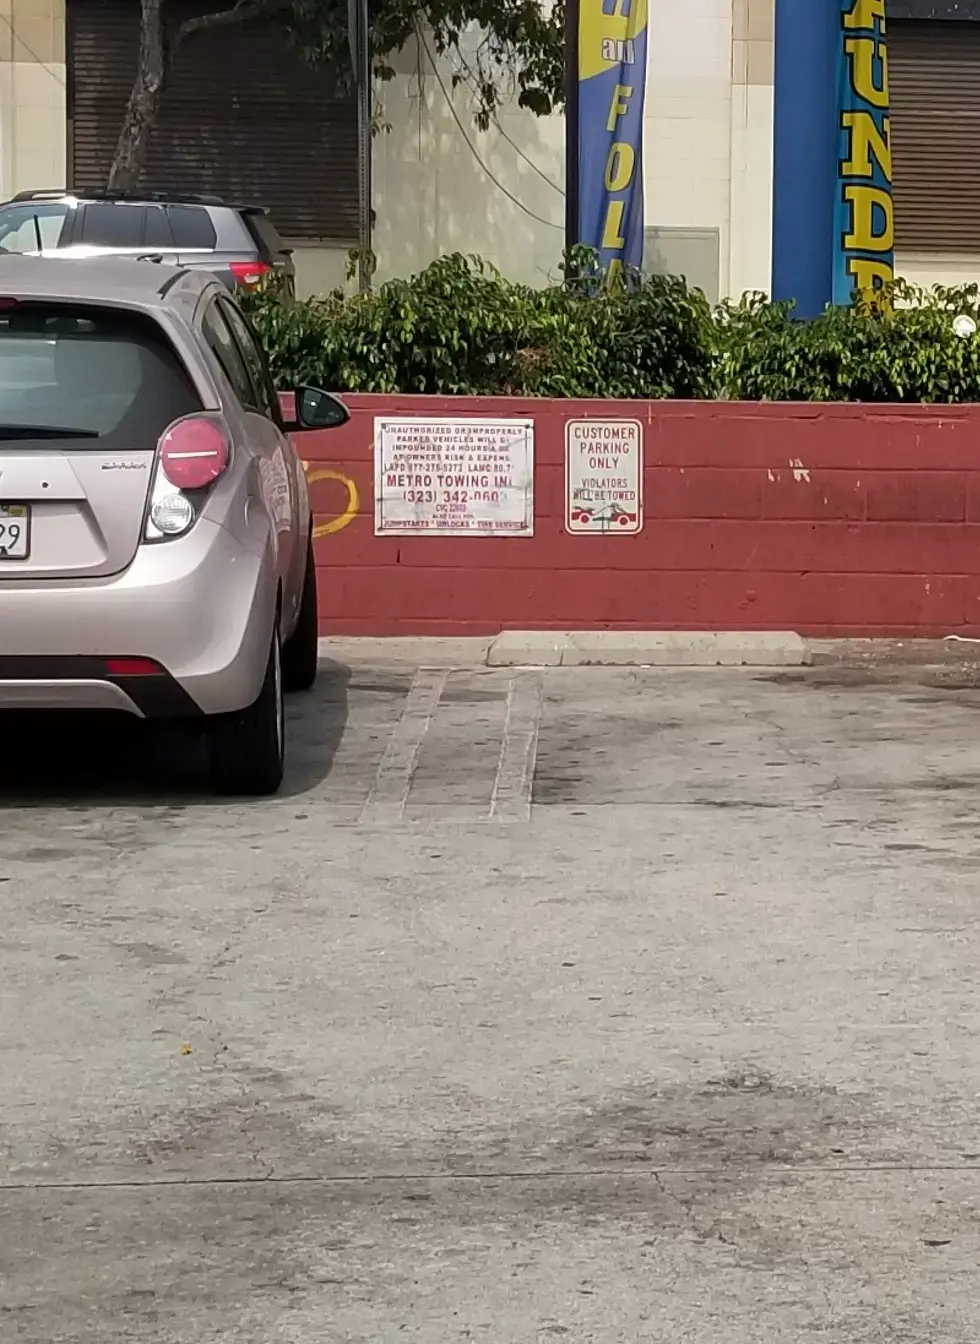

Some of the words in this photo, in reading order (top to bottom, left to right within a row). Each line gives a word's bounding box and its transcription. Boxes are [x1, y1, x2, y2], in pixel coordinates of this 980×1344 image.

[574, 427, 636, 439] CUSTOMER
[580, 442, 630, 454] PARKING
[477, 454, 510, 462] EXPENS
[589, 457, 619, 469] ONLY
[387, 474, 432, 487] METRO
[437, 475, 489, 487] TOWING
[581, 478, 628, 488] VIOLATORS
[403, 490, 437, 503] (323)
[443, 490, 507, 503] 342-060
[595, 490, 605, 500] BE
[608, 490, 636, 501] TOWED
